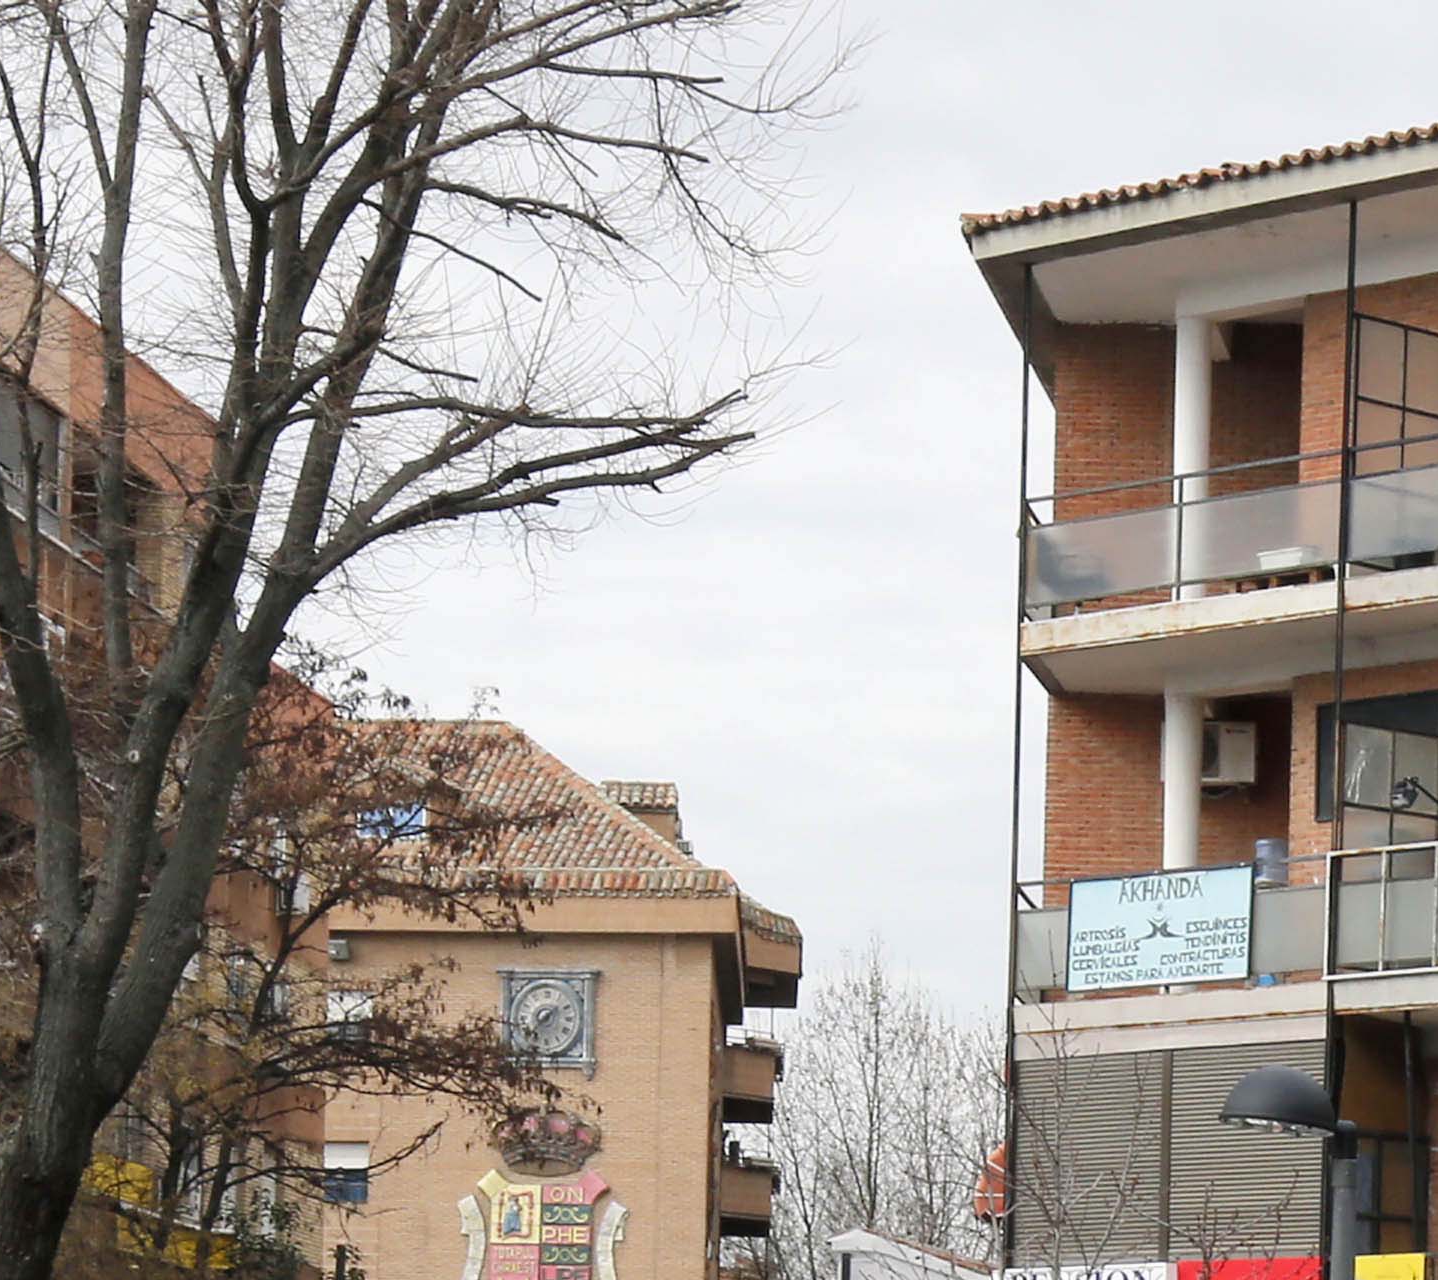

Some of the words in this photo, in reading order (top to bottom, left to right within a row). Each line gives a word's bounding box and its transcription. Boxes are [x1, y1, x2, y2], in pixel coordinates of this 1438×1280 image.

[1118, 875, 1203, 904] AKHANDA
[1074, 926, 1126, 942] ARTROSIS
[1160, 948, 1245, 966] CONTRACTURAS
[1137, 967, 1162, 981] PARA
[1167, 963, 1224, 977] AYUDARTE
[542, 1226, 588, 1243] PHE
